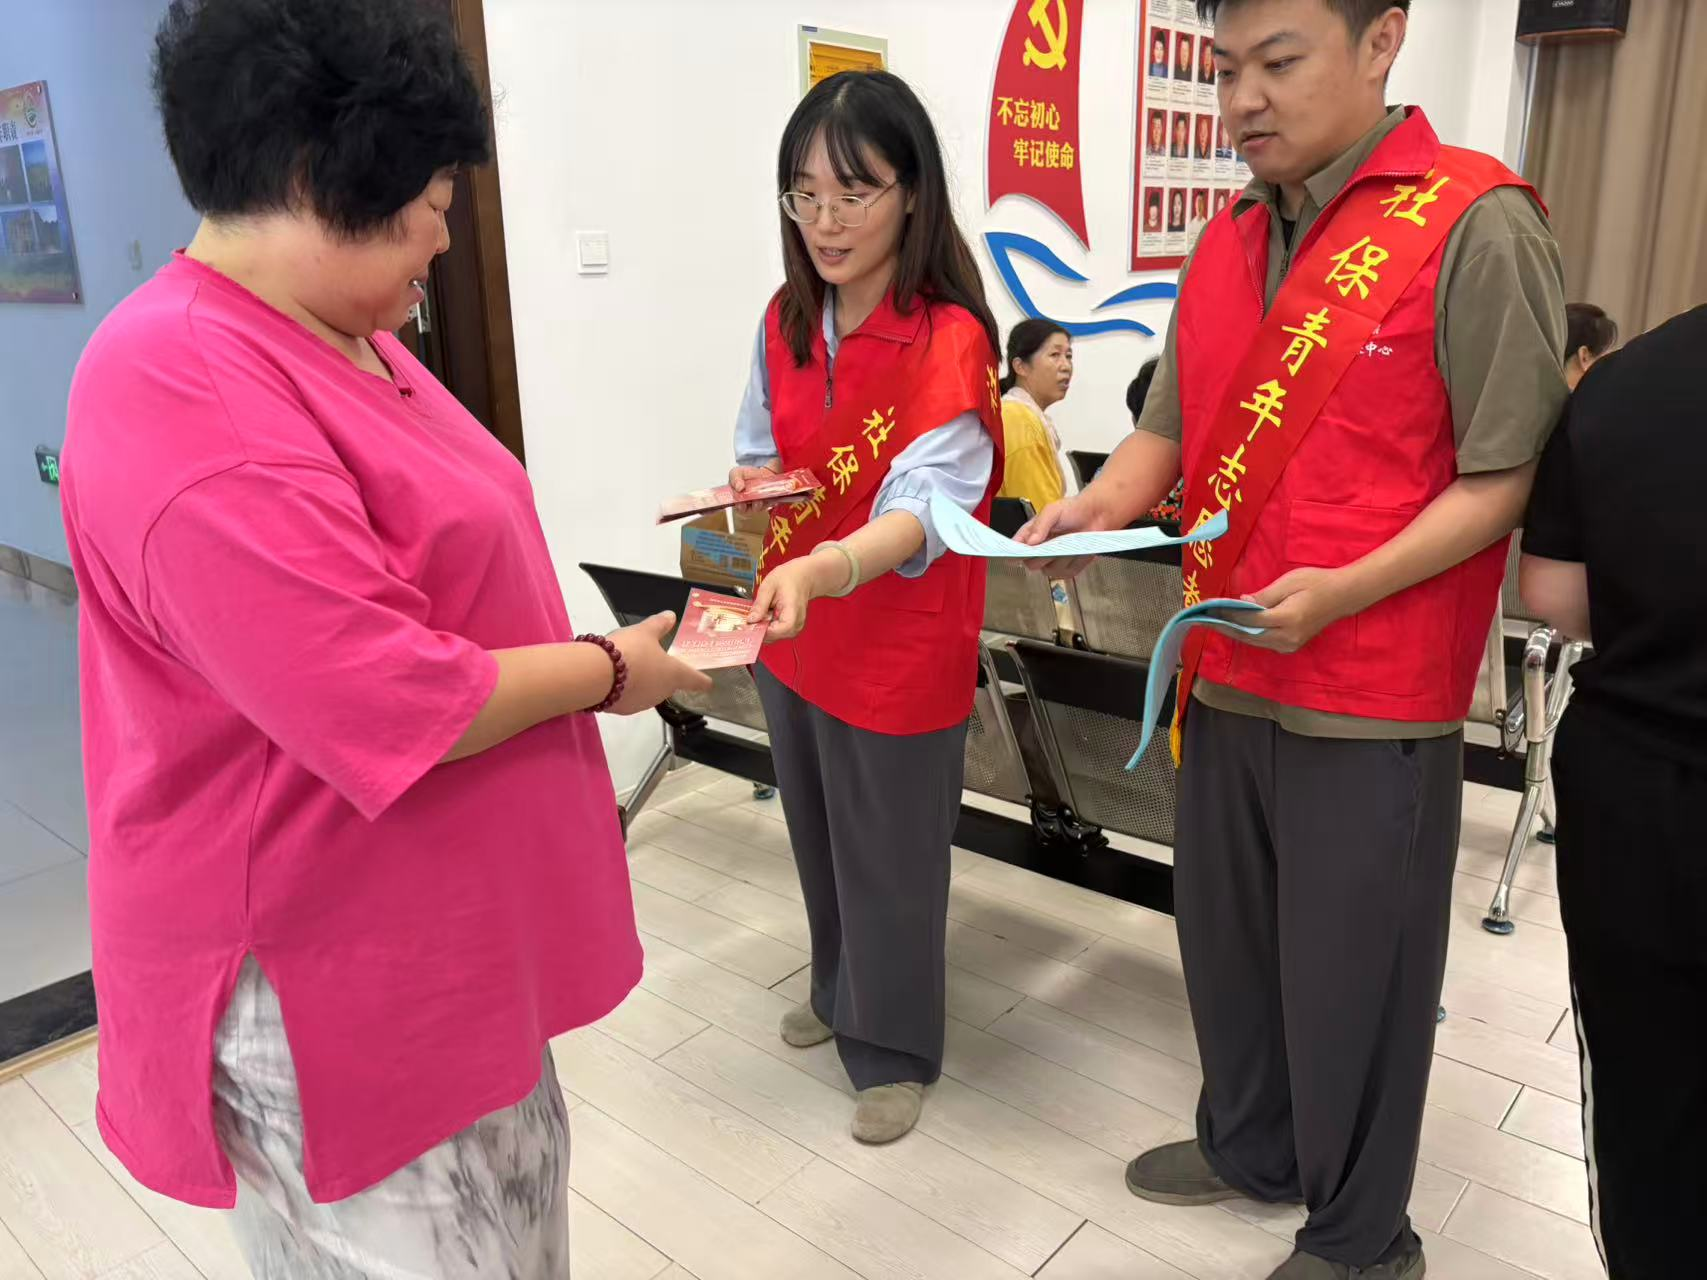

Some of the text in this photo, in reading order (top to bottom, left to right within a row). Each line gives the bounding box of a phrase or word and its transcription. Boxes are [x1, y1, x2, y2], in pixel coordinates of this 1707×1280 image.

[997, 96, 1060, 131] 不忘初心
[1013, 138, 1075, 170] 牢记使命
[1359, 341, 1393, 357] 中心
